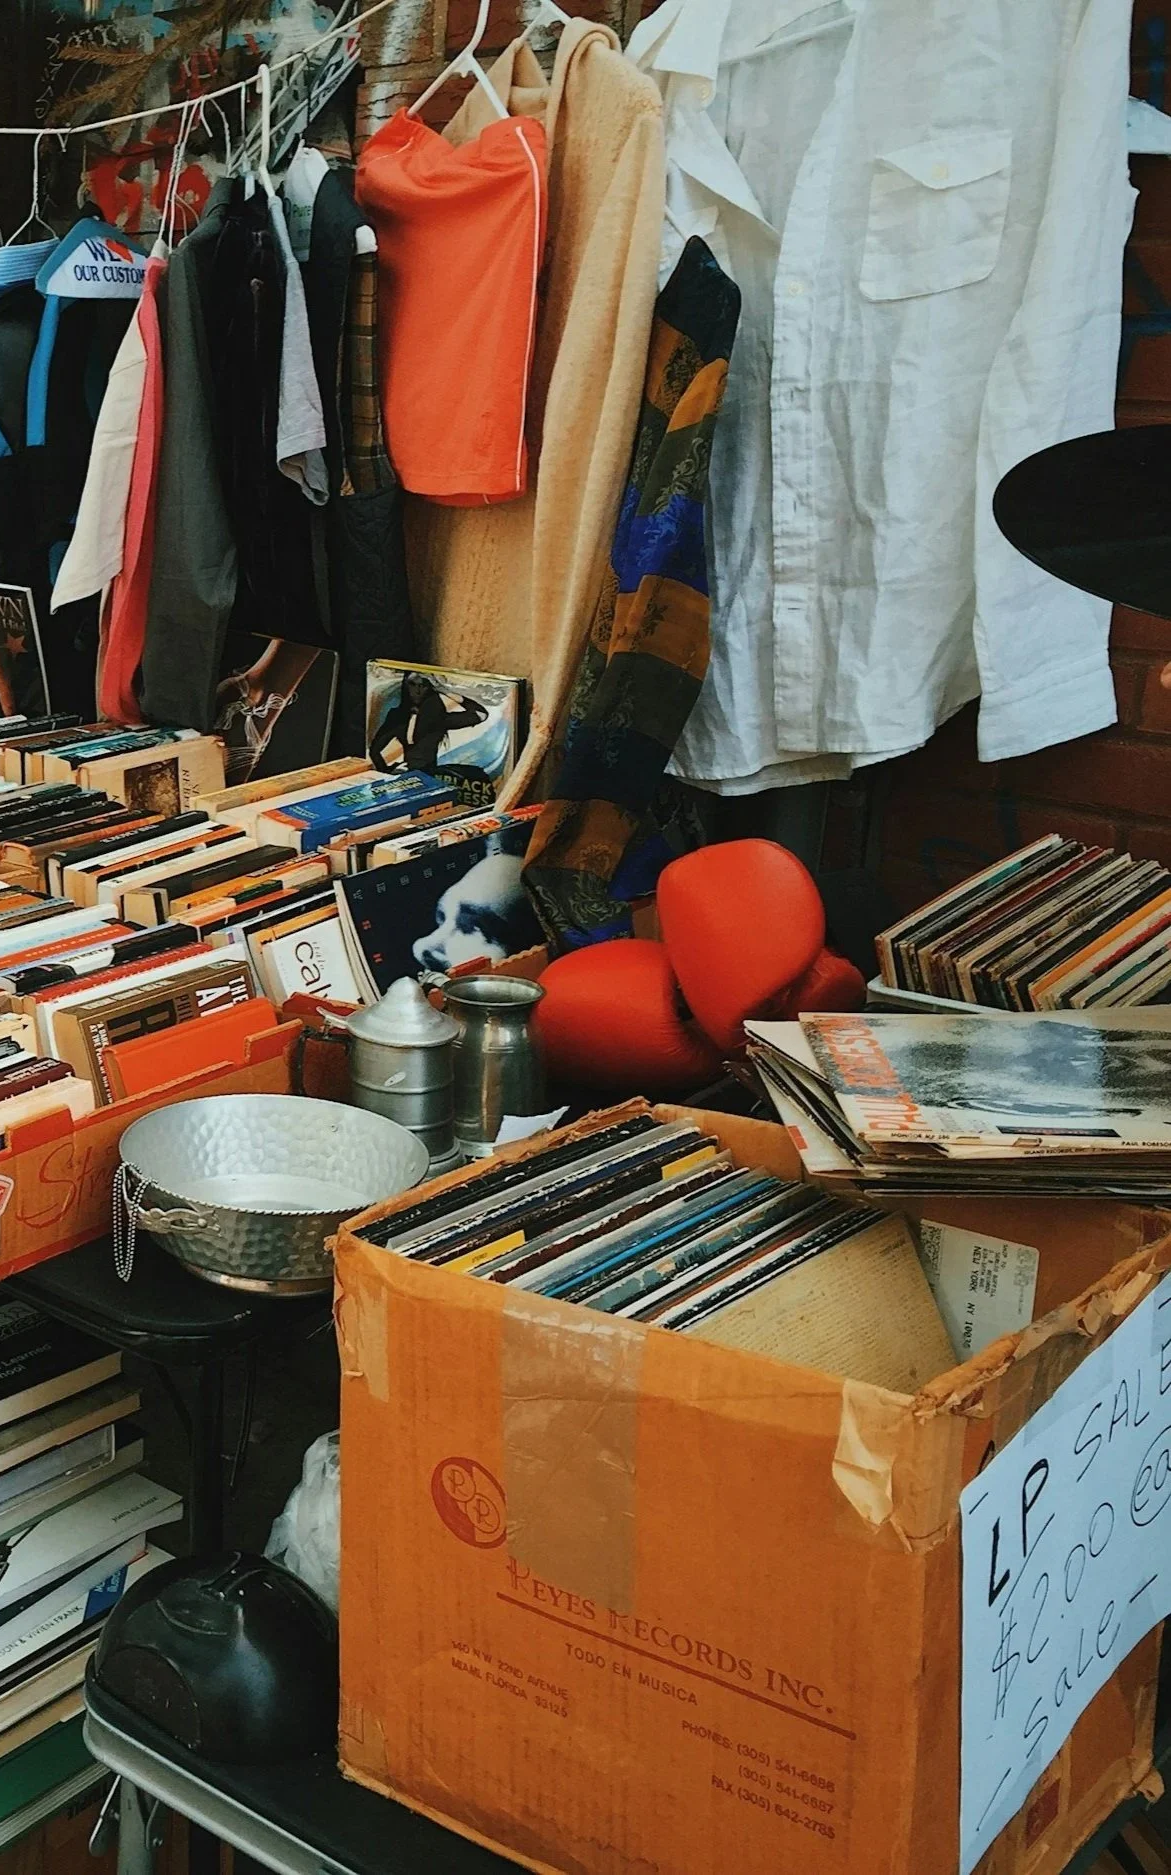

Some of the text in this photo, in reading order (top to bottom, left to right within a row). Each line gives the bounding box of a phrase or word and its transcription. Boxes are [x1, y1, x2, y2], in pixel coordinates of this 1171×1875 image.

[74, 264, 100, 282] OUR
[228, 974, 249, 1006] THE
[972, 1245, 982, 1265] NEW
[969, 1269, 980, 1294] YORK
[966, 1302, 976, 1316] NY
[987, 1337, 1171, 1609] LP SALE
[26, 1620, 55, 1640] VIVIEN
[53, 1605, 85, 1626] FRANK
[991, 1501, 1116, 1722] $2.00
[485, 1671, 528, 1701] FLORIDA
[527, 1674, 570, 1701] AVENUE
[564, 1641, 699, 1707] TODO EN MUSICA
[764, 1666, 834, 1716] INC.
[681, 1719, 734, 1750] PHONES:
[736, 1743, 772, 1768] (305)
[738, 1764, 772, 1790] (305)
[711, 1774, 734, 1795] FAX
[737, 1787, 772, 1813] (305)
